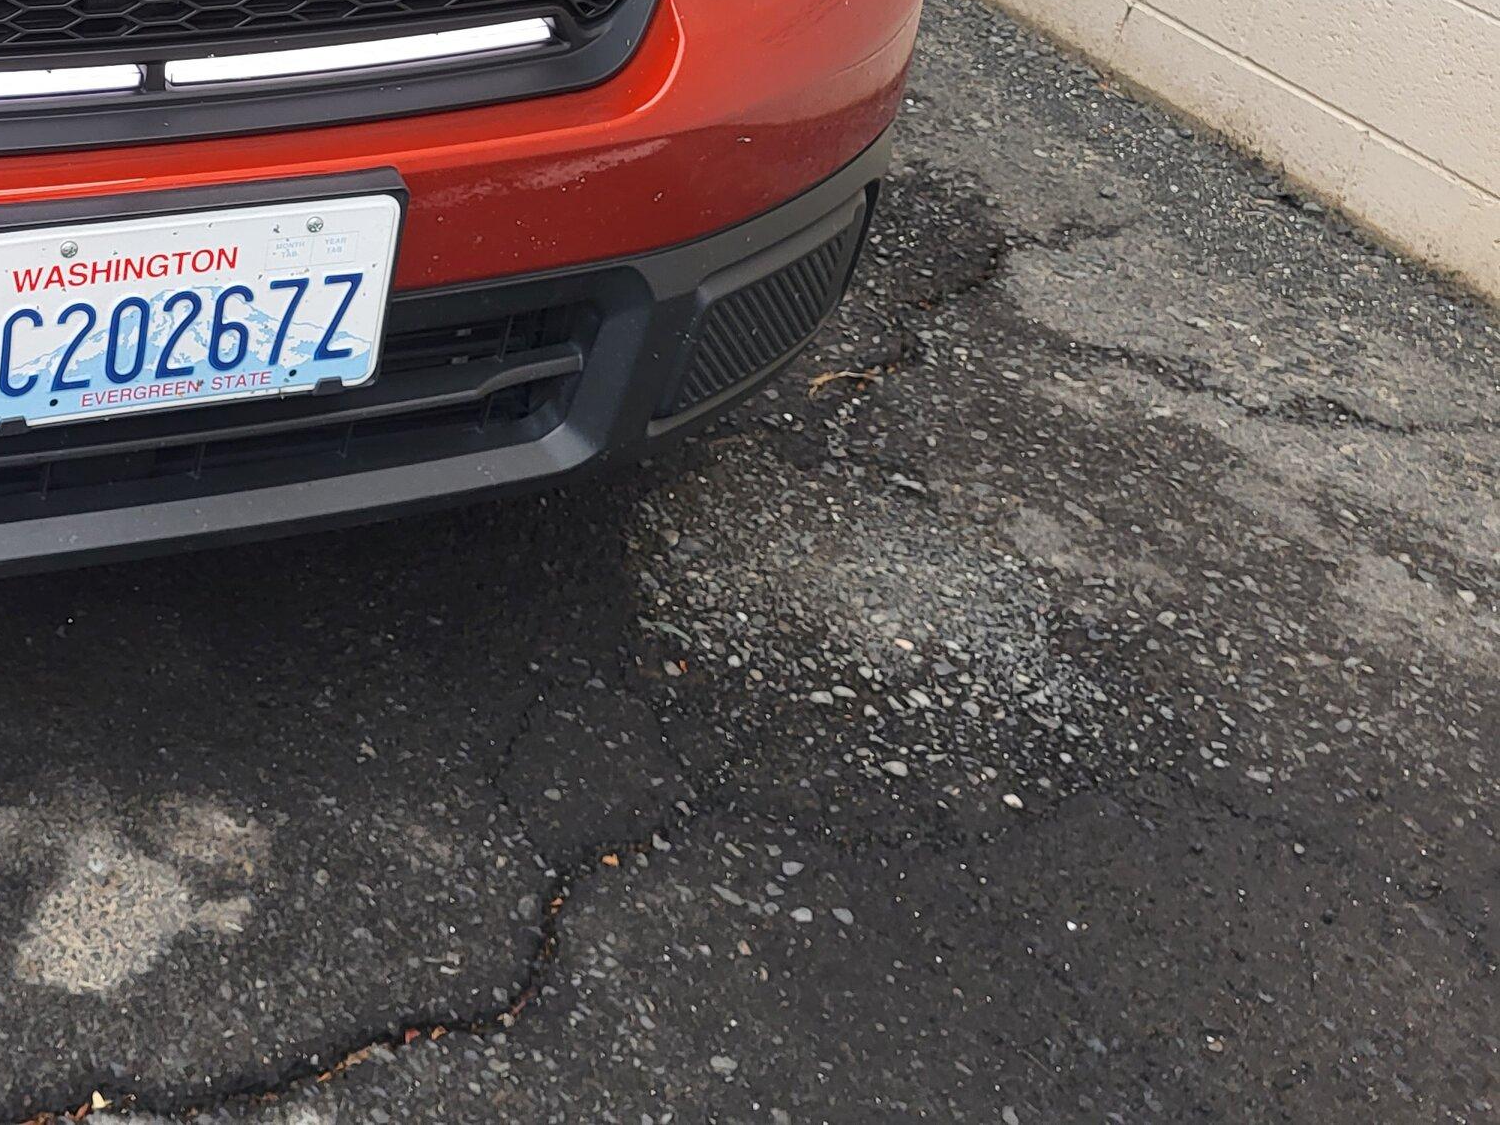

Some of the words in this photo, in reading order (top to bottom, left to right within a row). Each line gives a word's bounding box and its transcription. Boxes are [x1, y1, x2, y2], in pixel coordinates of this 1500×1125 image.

[275, 240, 306, 250] MONTH
[325, 236, 347, 245] YEAR
[12, 246, 239, 293] WASHINGTON
[81, 380, 200, 408] EVERGREEN
[211, 371, 272, 391] STATE
